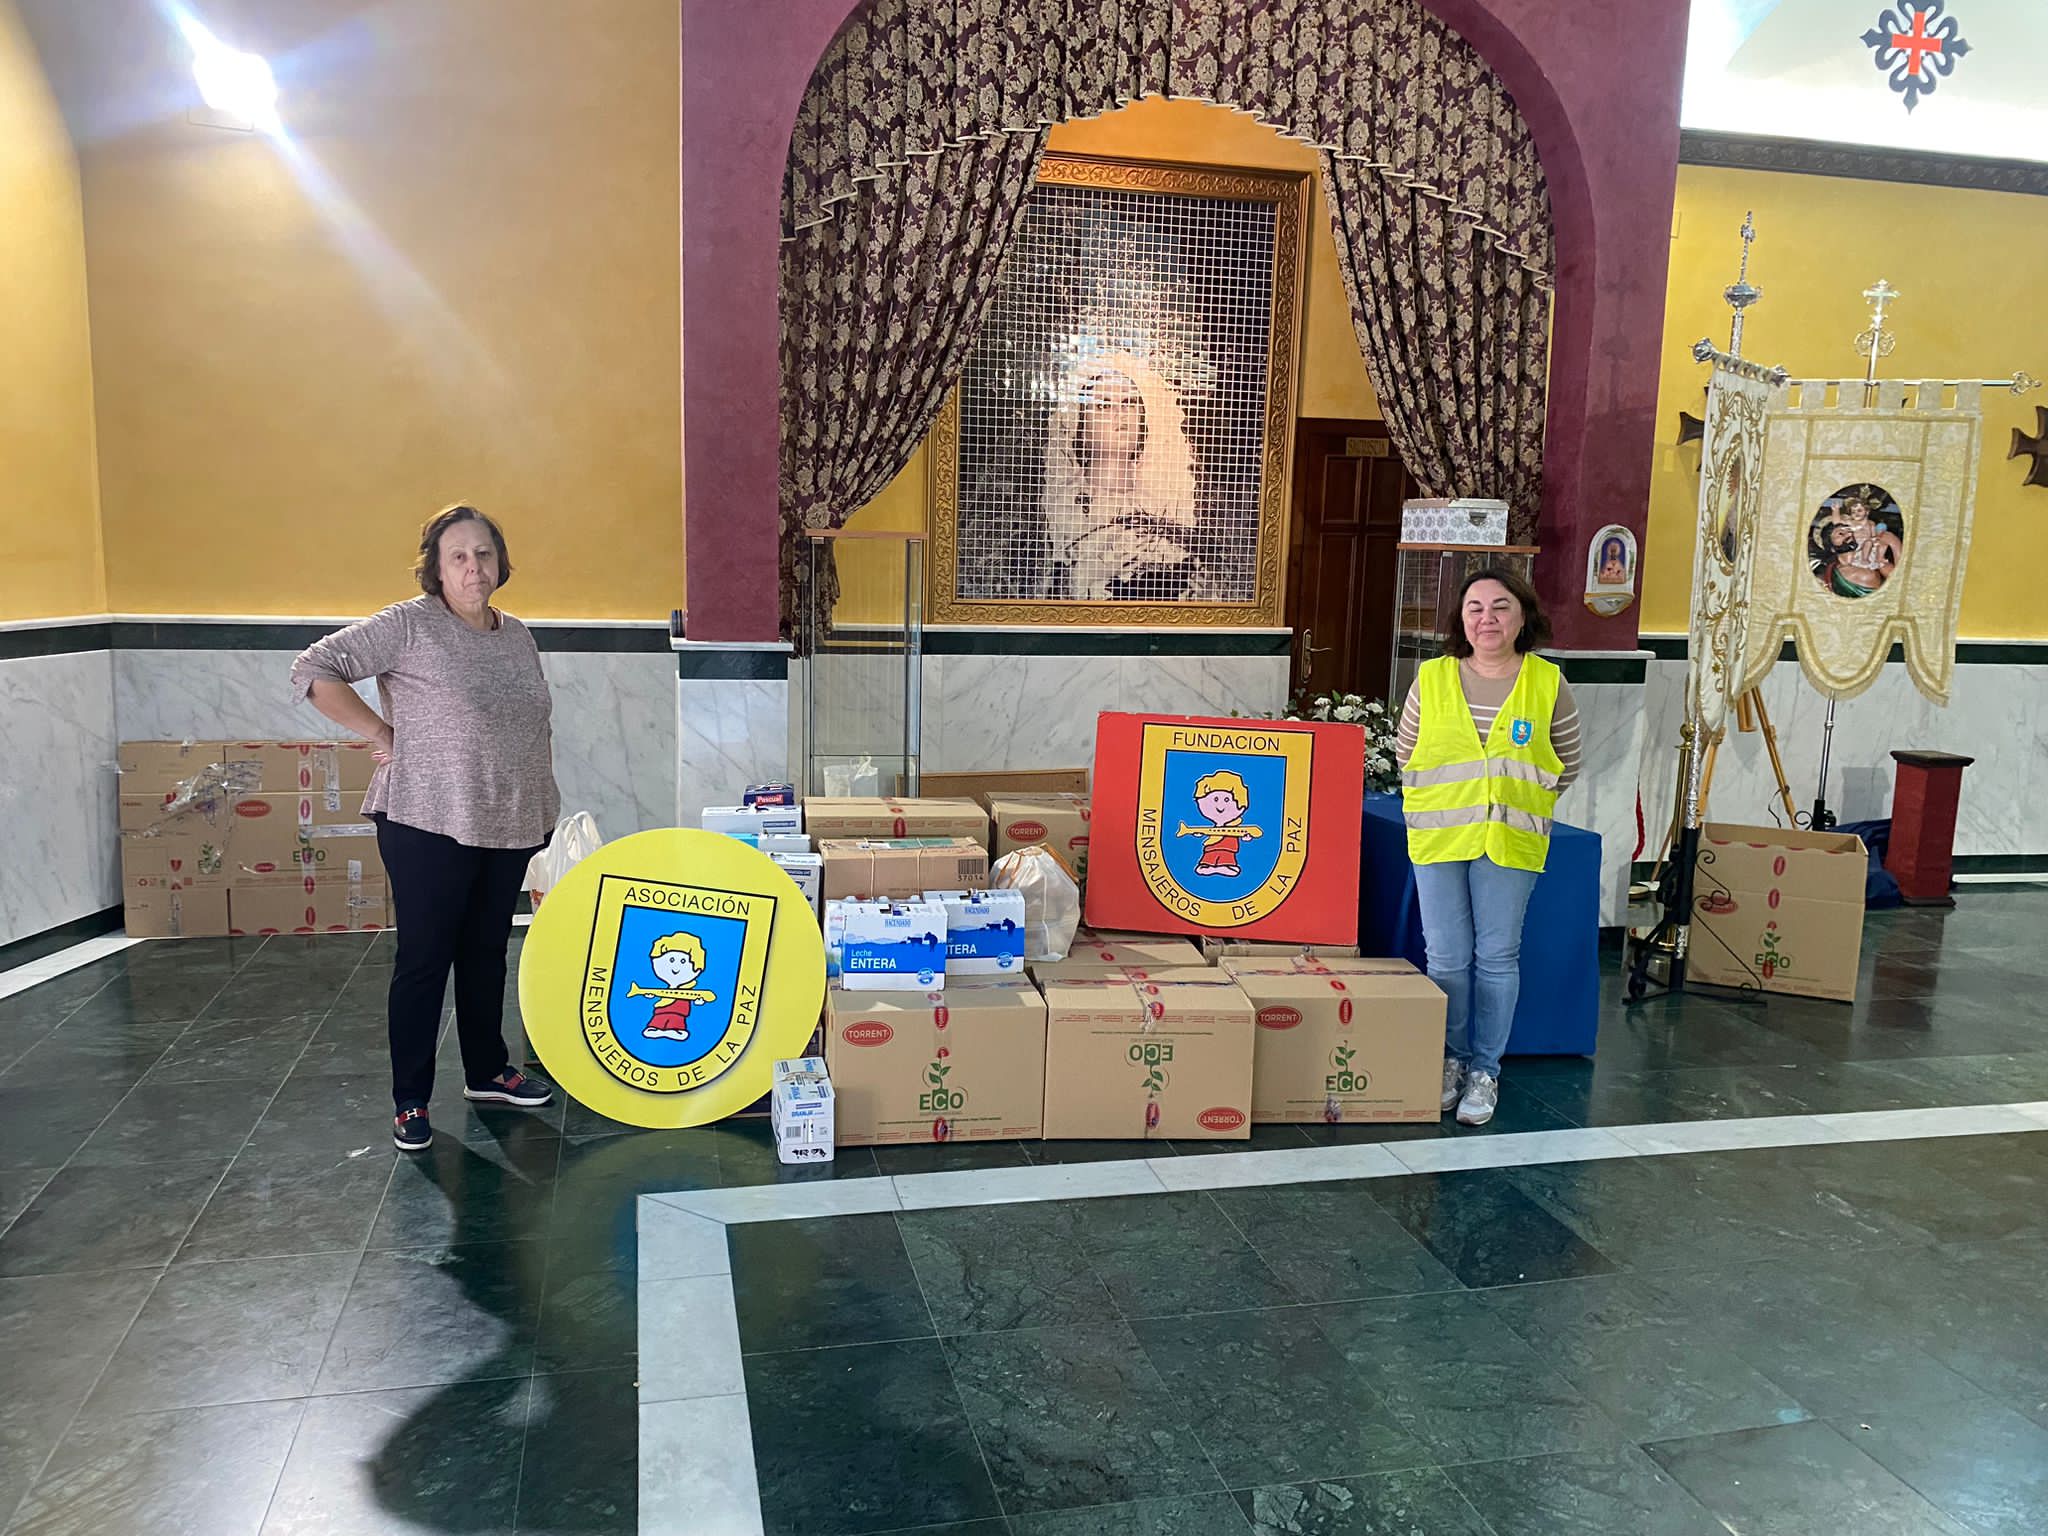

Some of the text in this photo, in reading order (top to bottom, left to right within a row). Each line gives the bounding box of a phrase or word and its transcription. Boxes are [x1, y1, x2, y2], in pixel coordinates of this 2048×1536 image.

[1173, 731, 1280, 751] FUNDACION
[757, 794, 782, 804] Pascual
[1010, 827, 1043, 836] TORRENT
[1141, 808, 1302, 921] MENSAJEROS DE LA PAZ
[624, 886, 751, 916] ASOCIACIÓN
[851, 949, 872, 957] Leche
[946, 943, 977, 955] TERA
[850, 958, 897, 969] ENTERA
[1260, 1013, 1298, 1022] TORRENT
[584, 967, 757, 1087] MENSAJEROS DE LA PAZ
[847, 1029, 888, 1039] TORRENT
[1129, 1043, 1174, 1062] ECO
[1325, 1073, 1368, 1092] ECO
[919, 1091, 964, 1111] ECO
[1202, 1115, 1242, 1124] TORRENT
